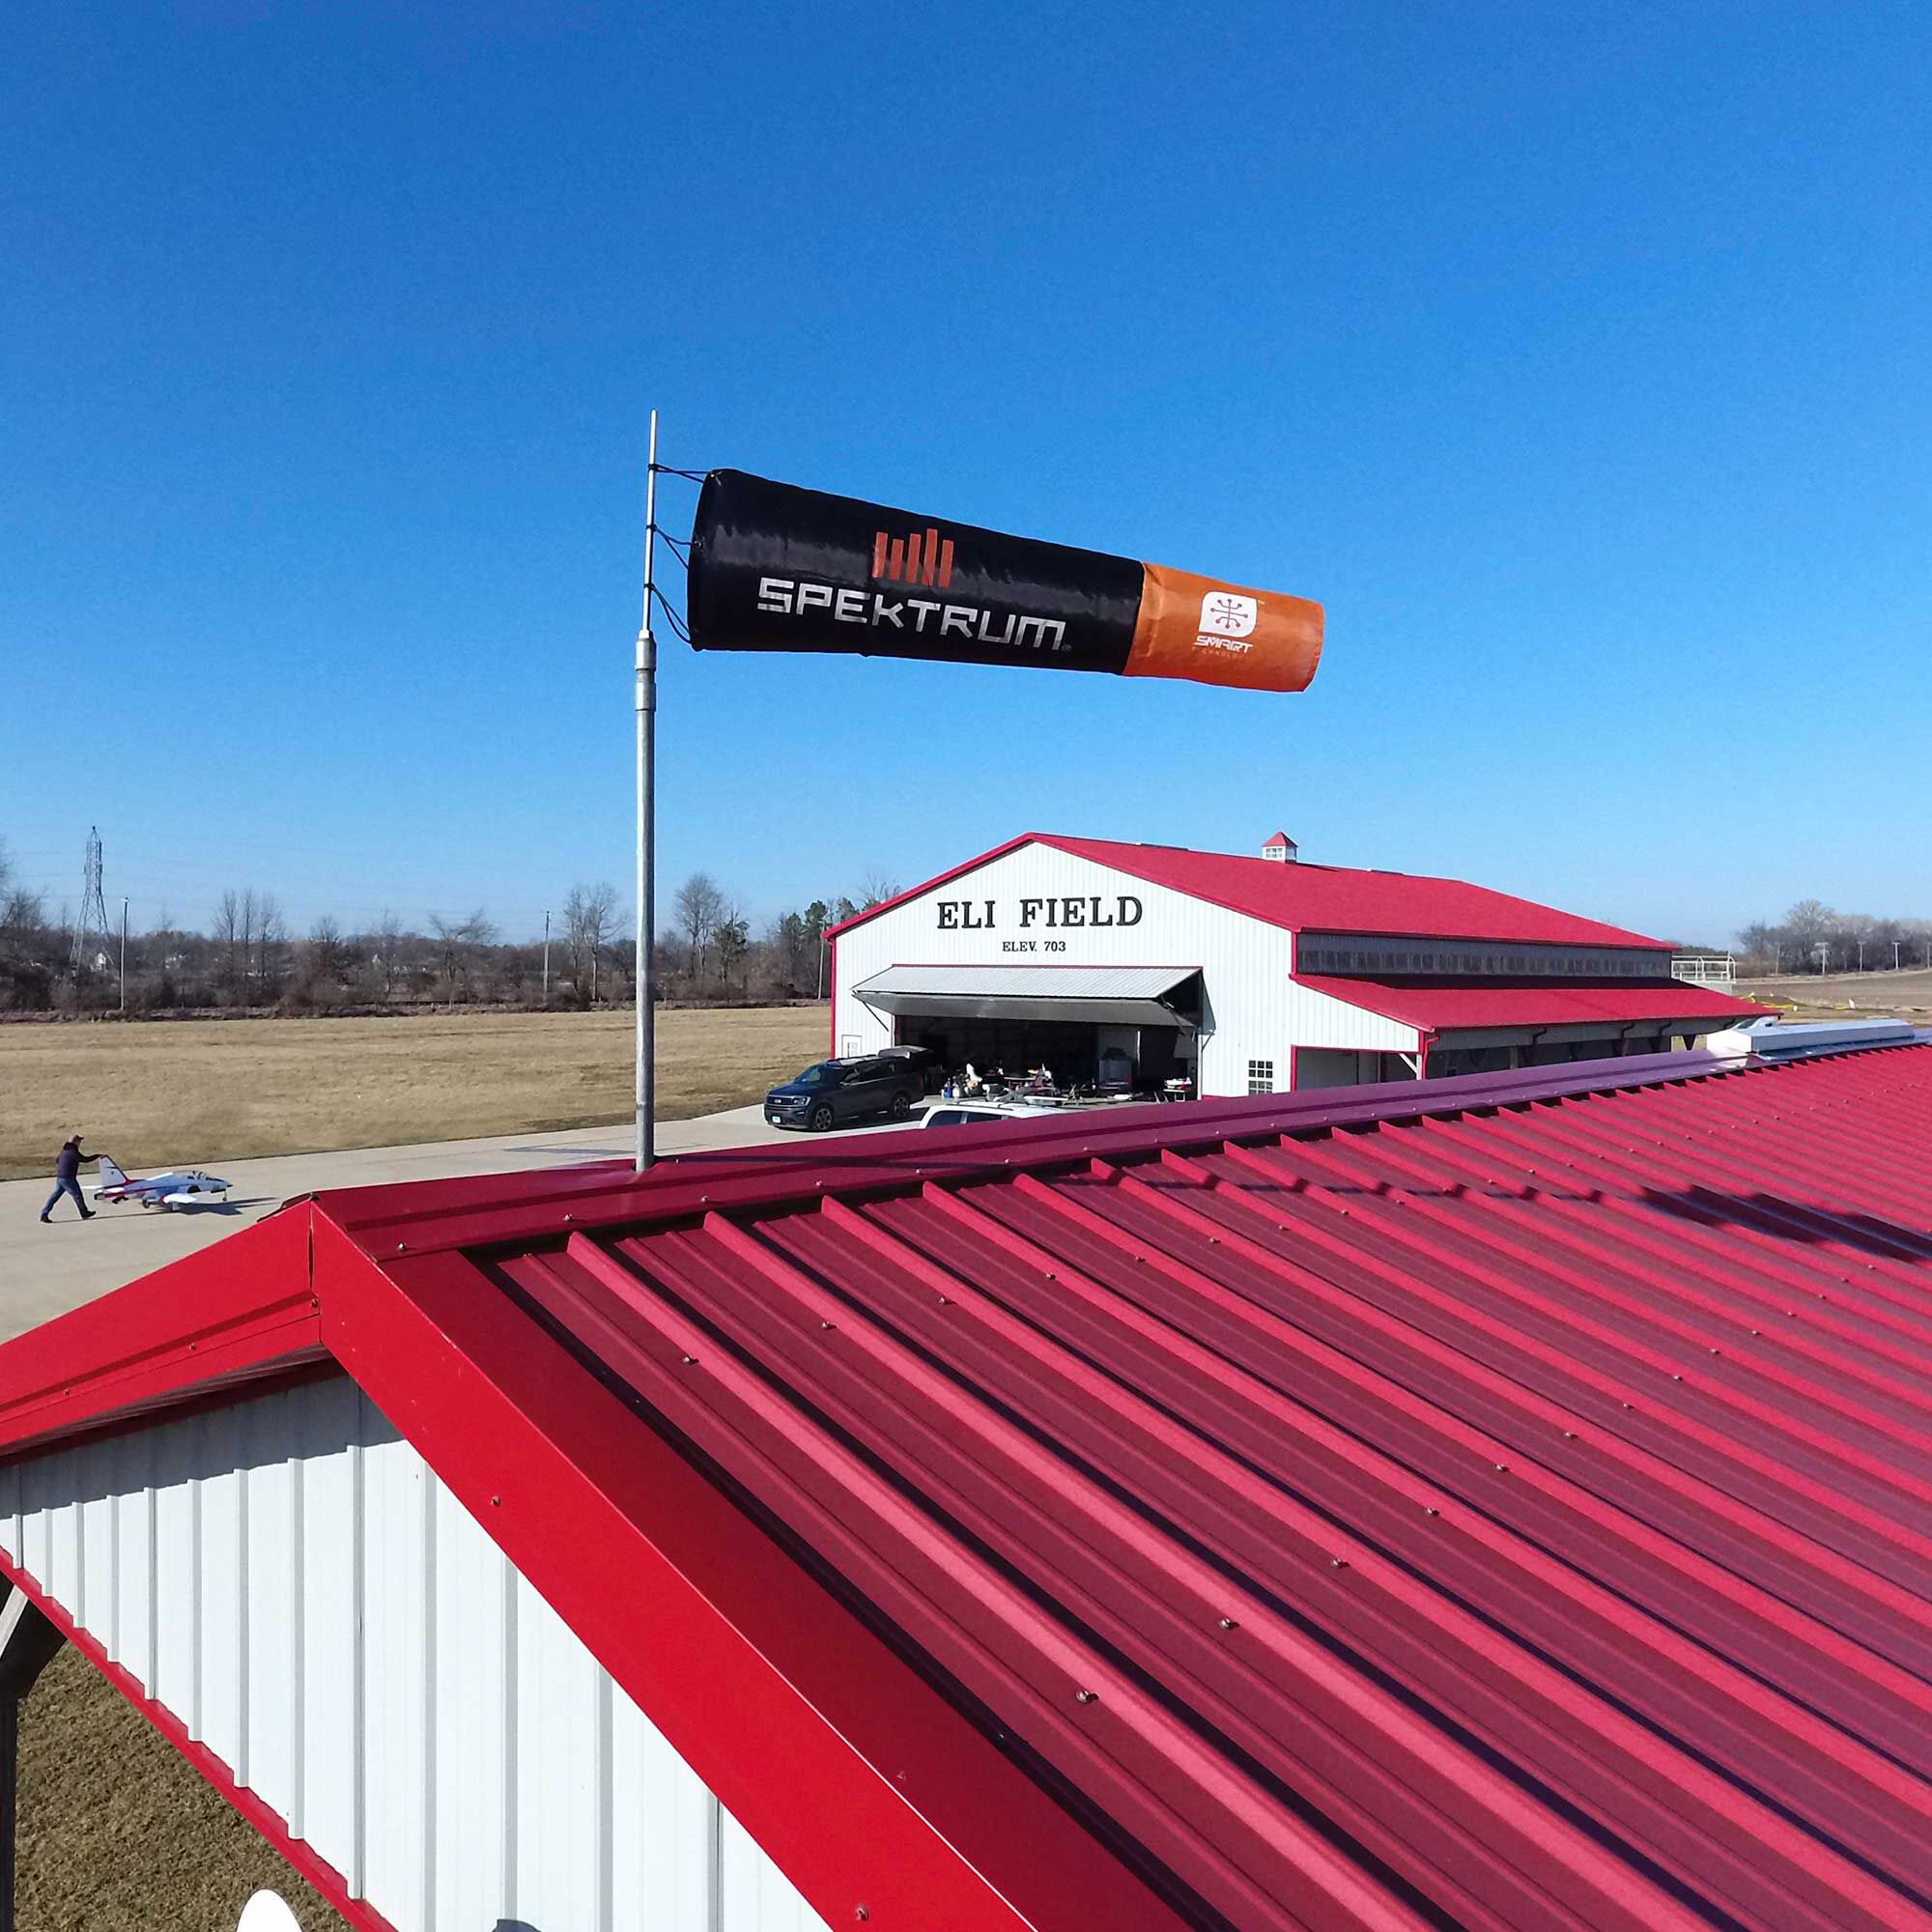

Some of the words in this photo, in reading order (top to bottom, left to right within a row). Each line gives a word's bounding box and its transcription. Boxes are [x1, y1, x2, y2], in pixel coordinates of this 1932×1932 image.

[757, 577, 1066, 650] SPEKTRUM
[1193, 635, 1254, 653] SMART
[937, 900, 996, 928] ELI
[1019, 895, 1143, 927] FIELD
[1002, 941, 1037, 952] ELEV.
[1044, 941, 1066, 952] 703
